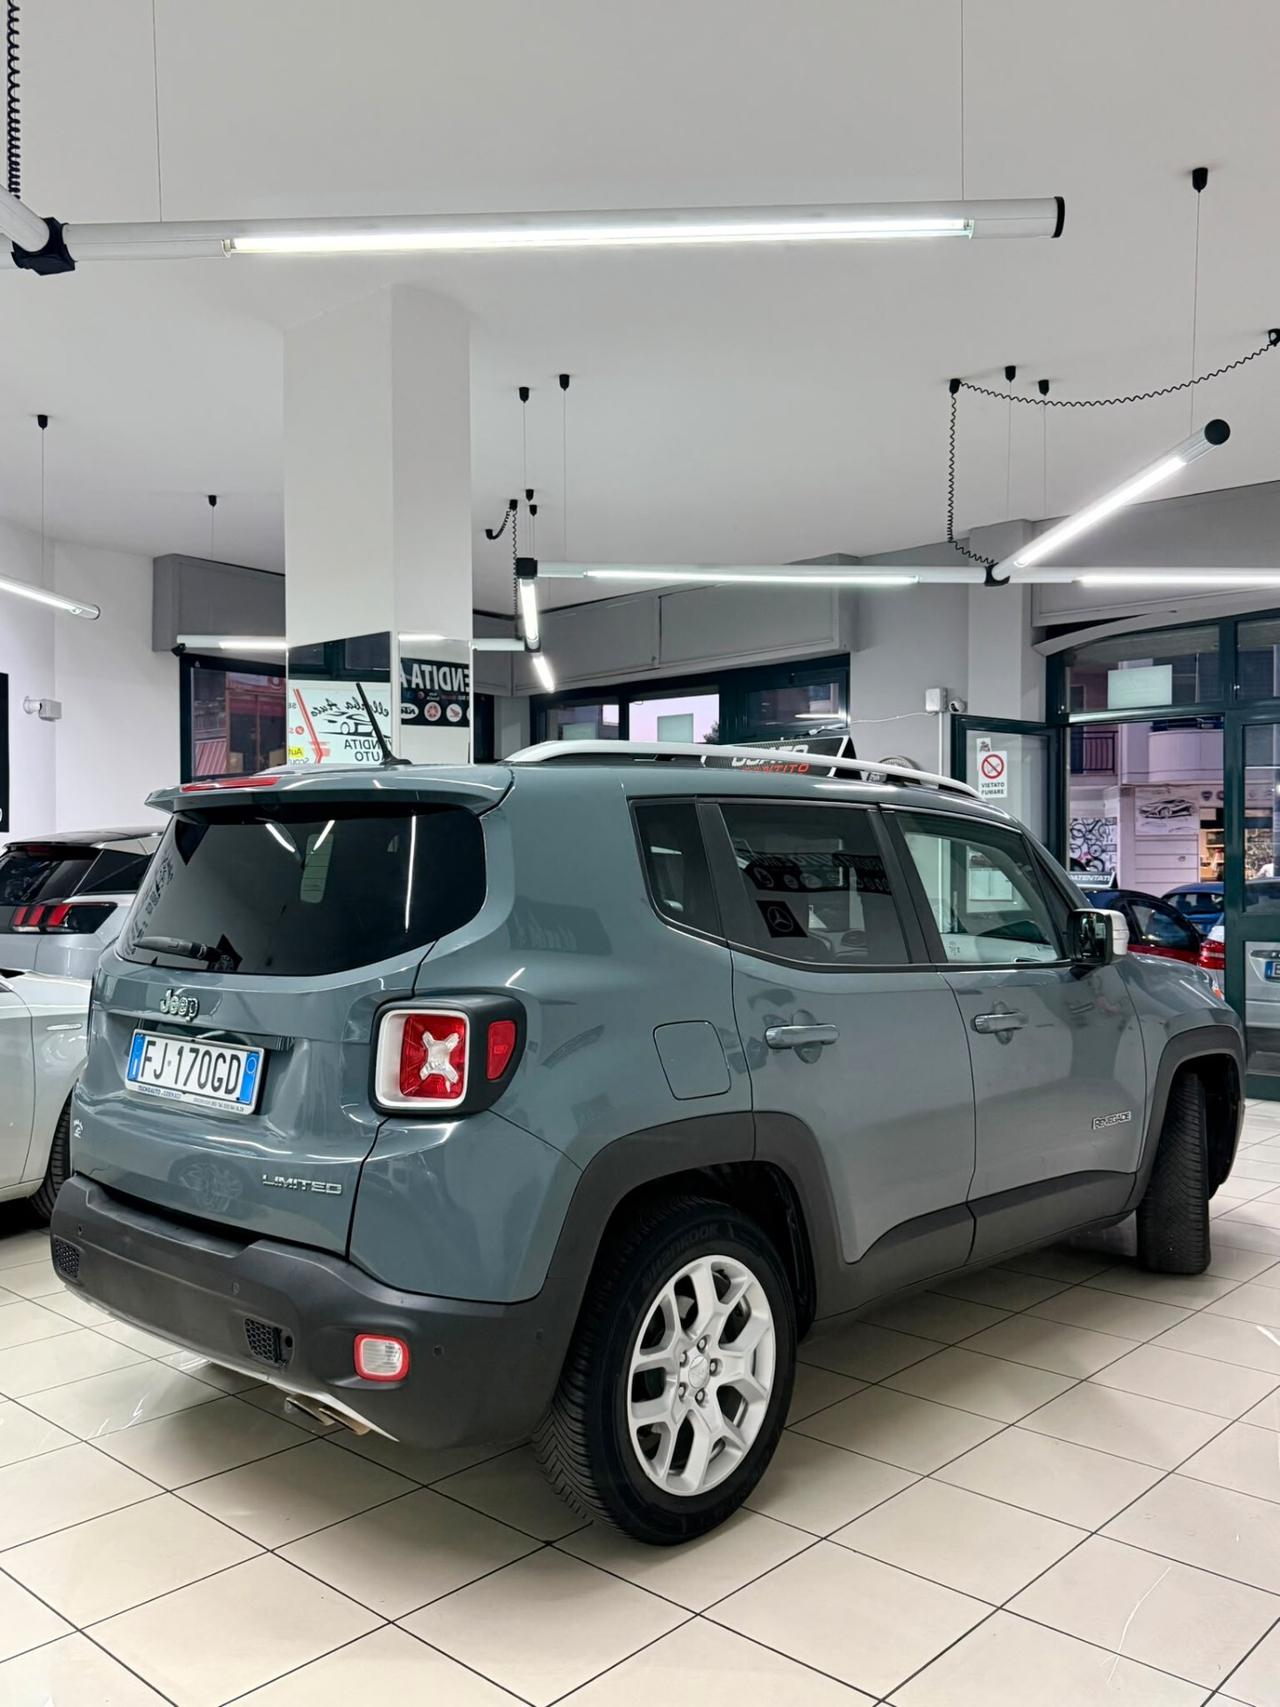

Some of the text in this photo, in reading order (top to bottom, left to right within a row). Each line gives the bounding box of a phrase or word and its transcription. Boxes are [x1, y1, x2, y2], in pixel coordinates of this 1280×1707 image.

[160, 989, 199, 1021] Jeep
[1092, 1111, 1131, 1130] RENEGADE
[262, 1174, 342, 1195] LIMITED
